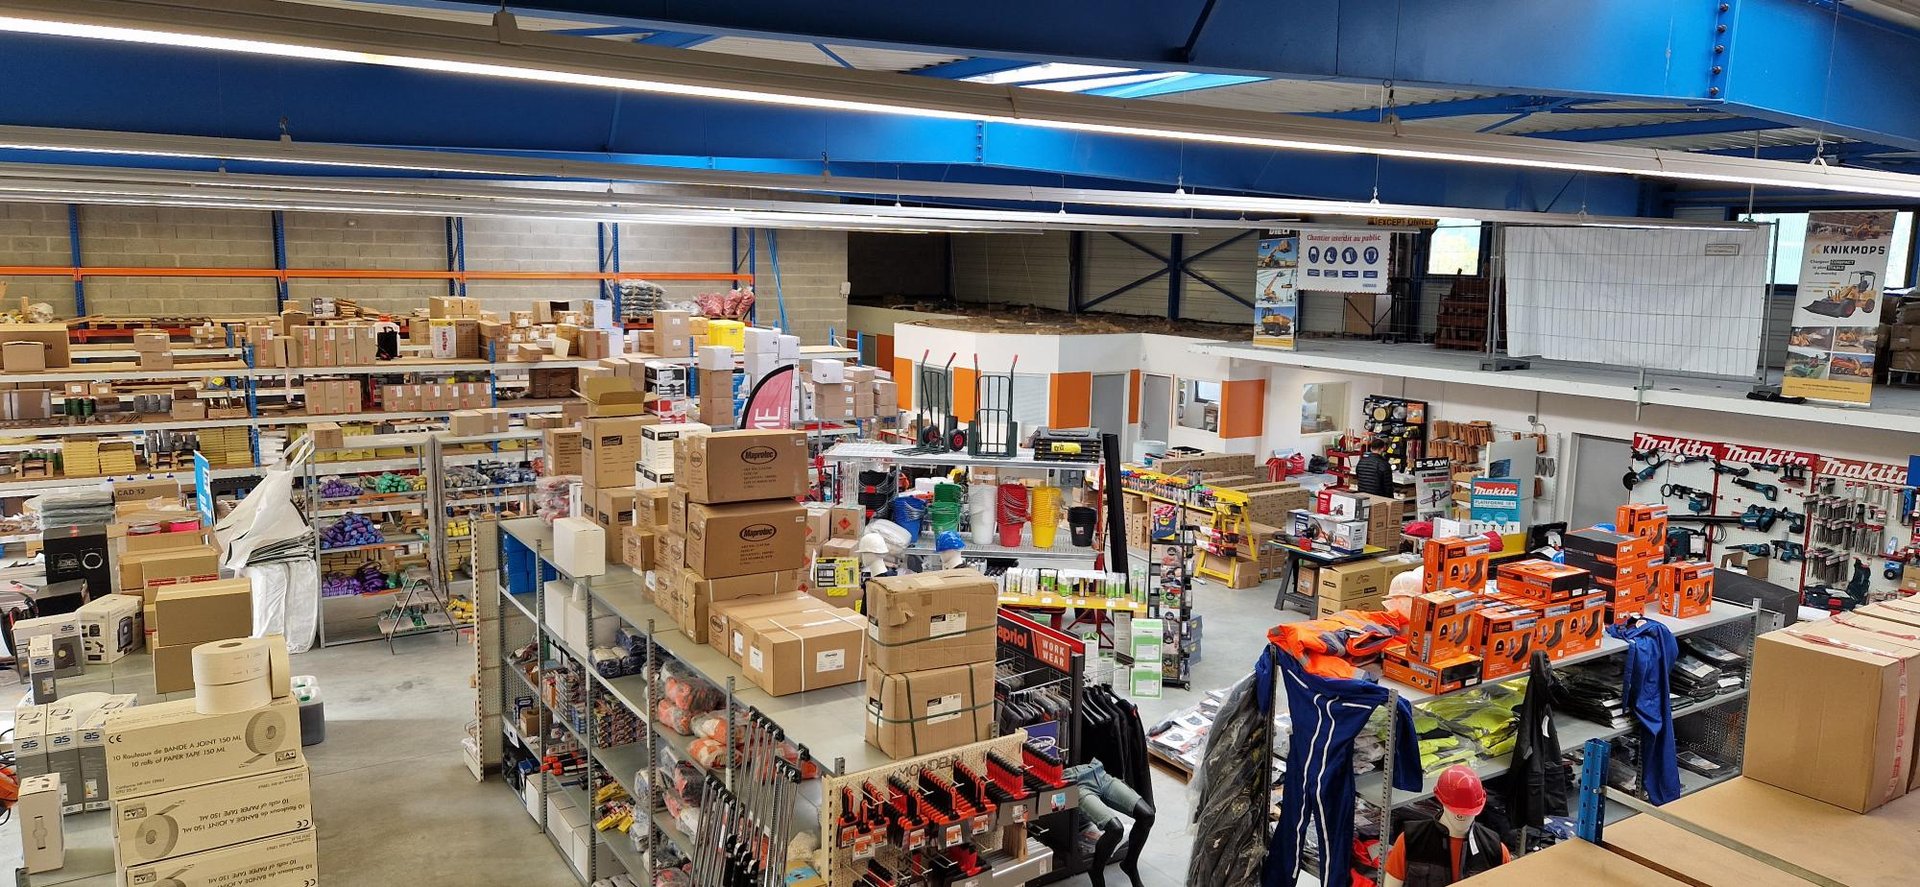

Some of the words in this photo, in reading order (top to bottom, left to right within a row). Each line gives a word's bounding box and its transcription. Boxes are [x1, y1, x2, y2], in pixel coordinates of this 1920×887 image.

[1307, 234, 1331, 242] Chantier
[1361, 234, 1382, 243] public
[1823, 245, 1886, 255] KNIKMOPS
[1416, 459, 1448, 468] E-SAW
[61, 624, 75, 632] as
[1042, 639, 1065, 657] WORK
[34, 657, 50, 666] as
[1042, 650, 1065, 667] WEAR
[54, 735, 71, 744] as
[84, 731, 100, 740] as
[21, 740, 39, 749] as
[154, 748, 162, 756] de
[163, 743, 188, 754] BANDE
[196, 738, 217, 748] JOINT
[219, 736, 231, 744] 150
[232, 734, 242, 742] ML
[163, 753, 184, 763] PAPER
[185, 751, 201, 760] TAPE
[203, 748, 215, 756] 150
